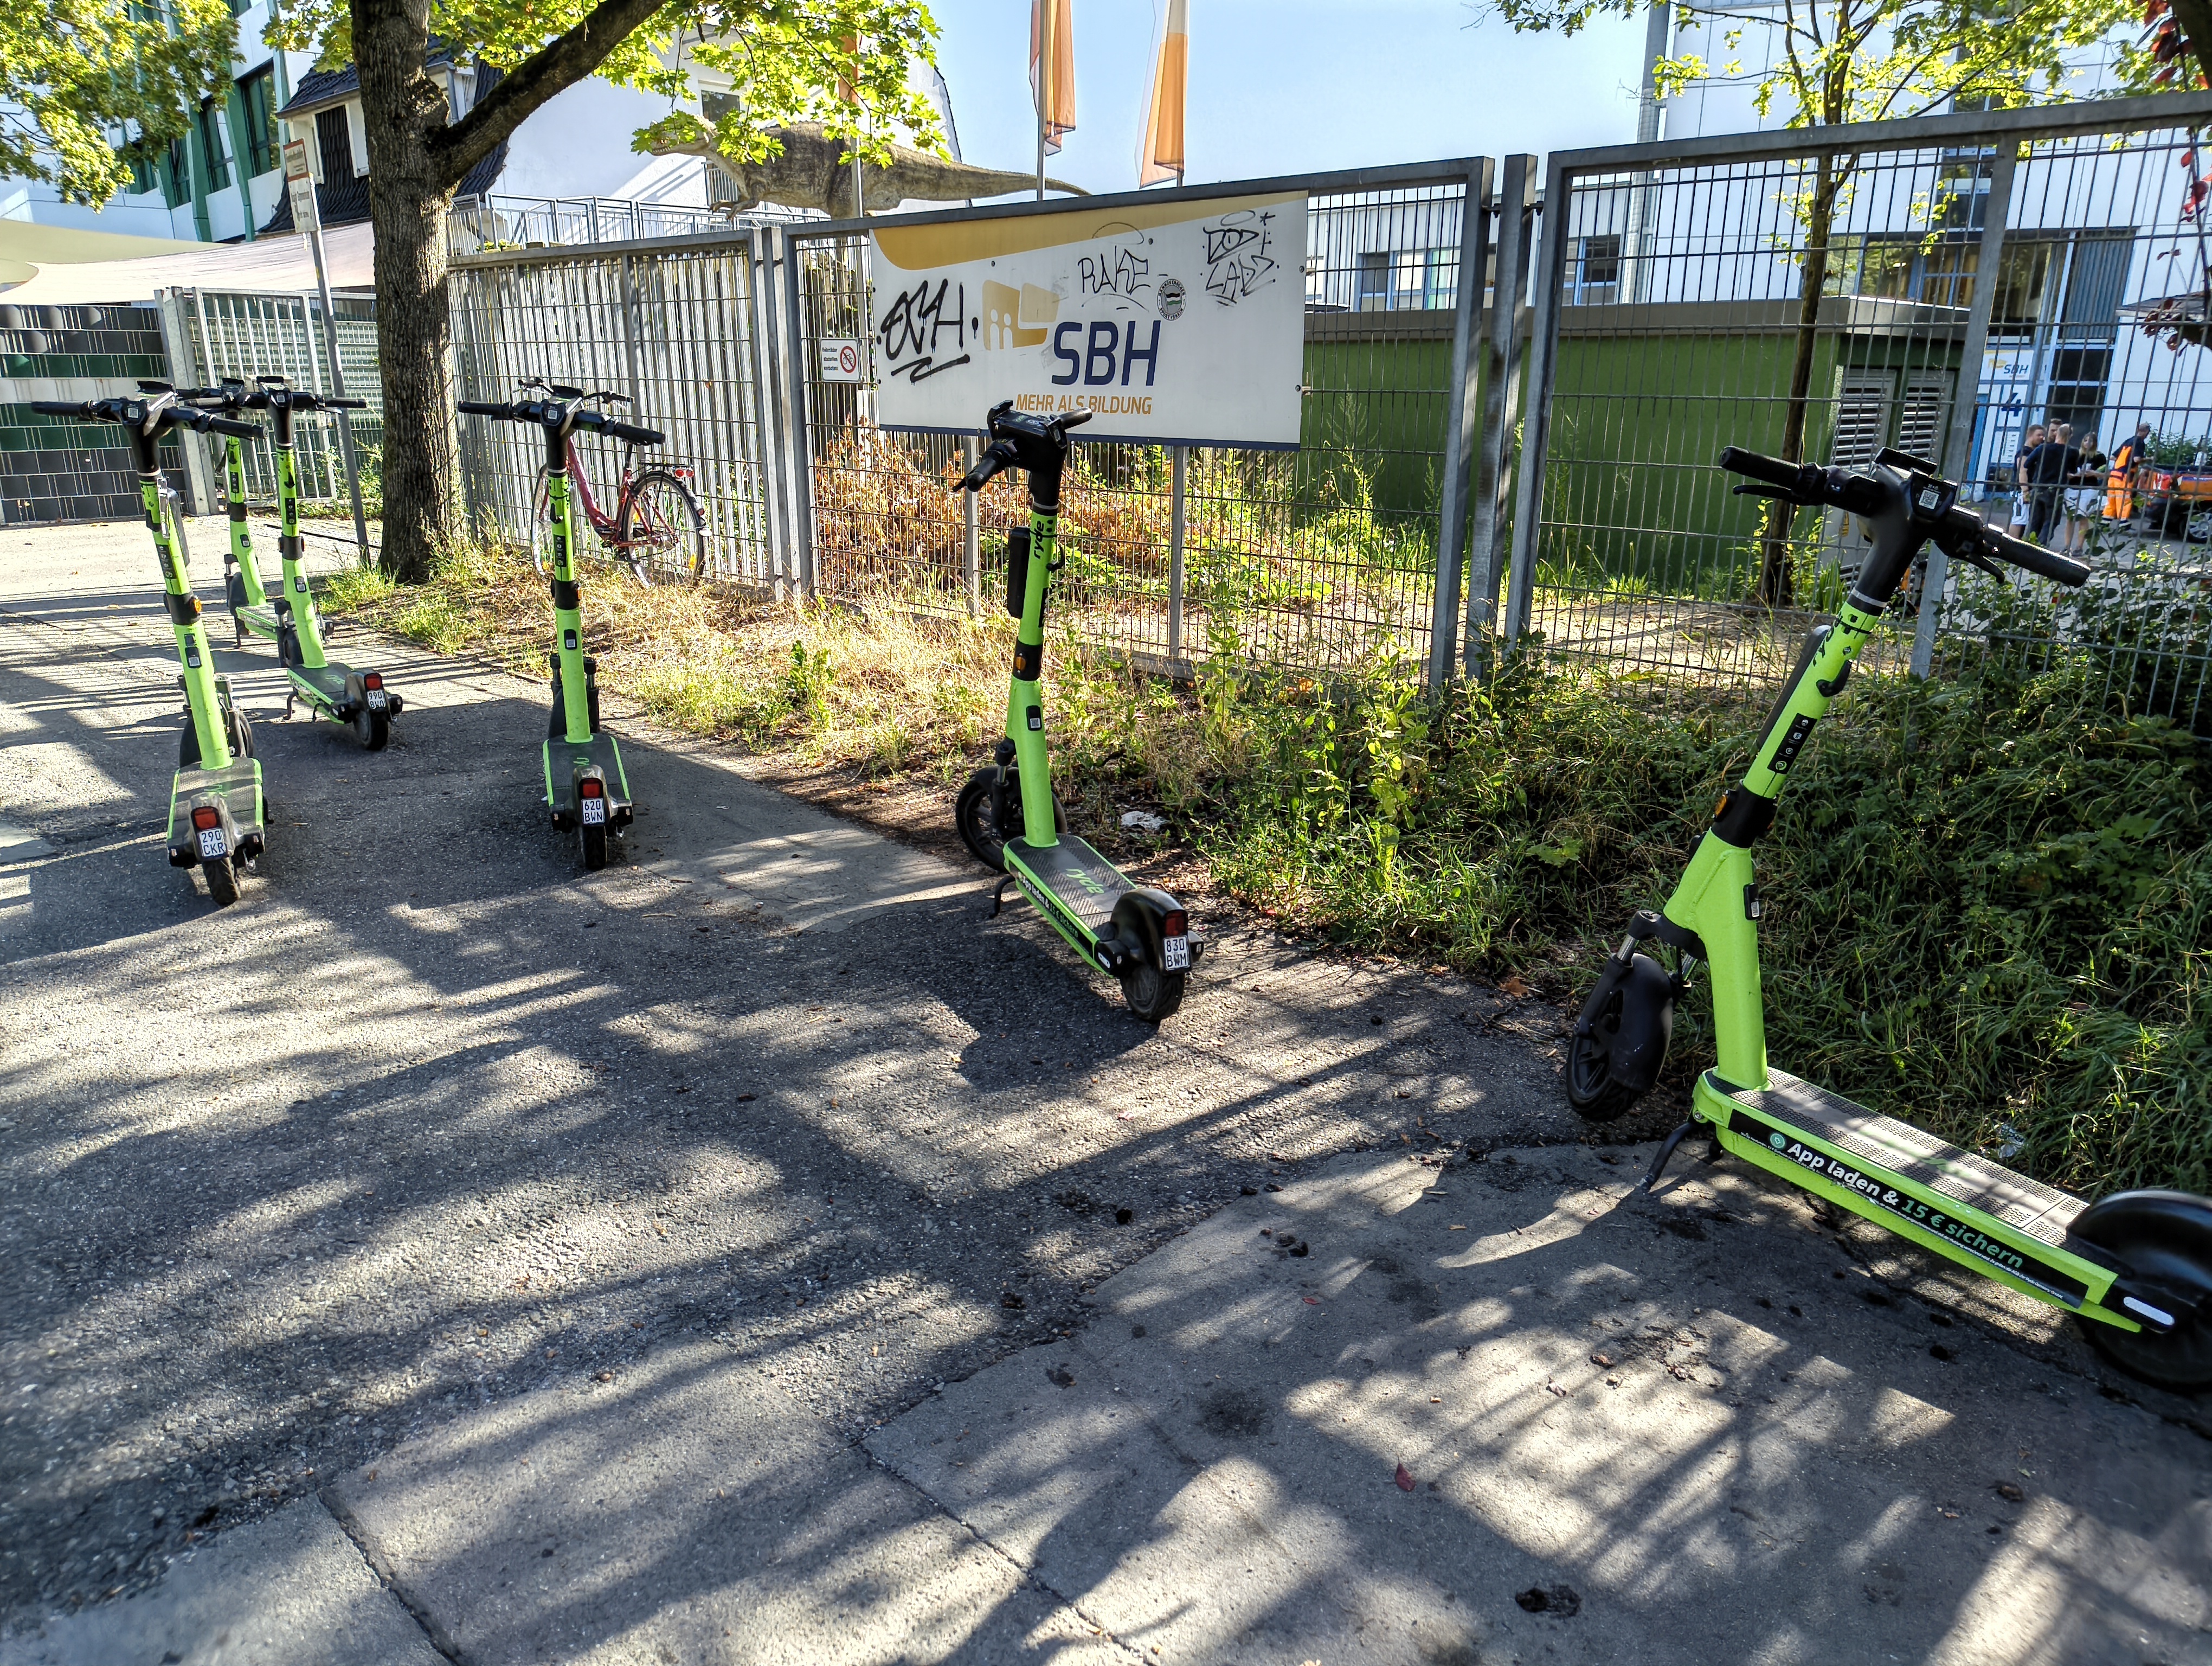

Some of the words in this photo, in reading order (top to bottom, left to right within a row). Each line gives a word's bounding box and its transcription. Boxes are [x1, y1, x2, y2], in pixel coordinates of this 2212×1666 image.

[1051, 320, 1161, 386] SBH
[1015, 394, 1054, 412] MEHR
[1057, 395, 1084, 412] ALS
[1089, 395, 1152, 415] BILDUNG
[2001, 392, 2023, 417] 4
[1033, 520, 1045, 560] ryde
[368, 691, 382, 700] 990
[584, 800, 601, 811] 620
[585, 811, 602, 822] BWN
[201, 830, 221, 843] 290
[203, 842, 225, 855] CKR
[1065, 868, 1104, 894] ryde
[1166, 938, 1185, 952] 830
[1787, 1143, 1825, 1168] App
[1827, 1160, 1880, 1196] laden
[1882, 1190, 1899, 1206] &
[1901, 1199, 1928, 1219] 15
[1930, 1214, 1946, 1227] €
[1945, 1223, 2023, 1268] sichern
